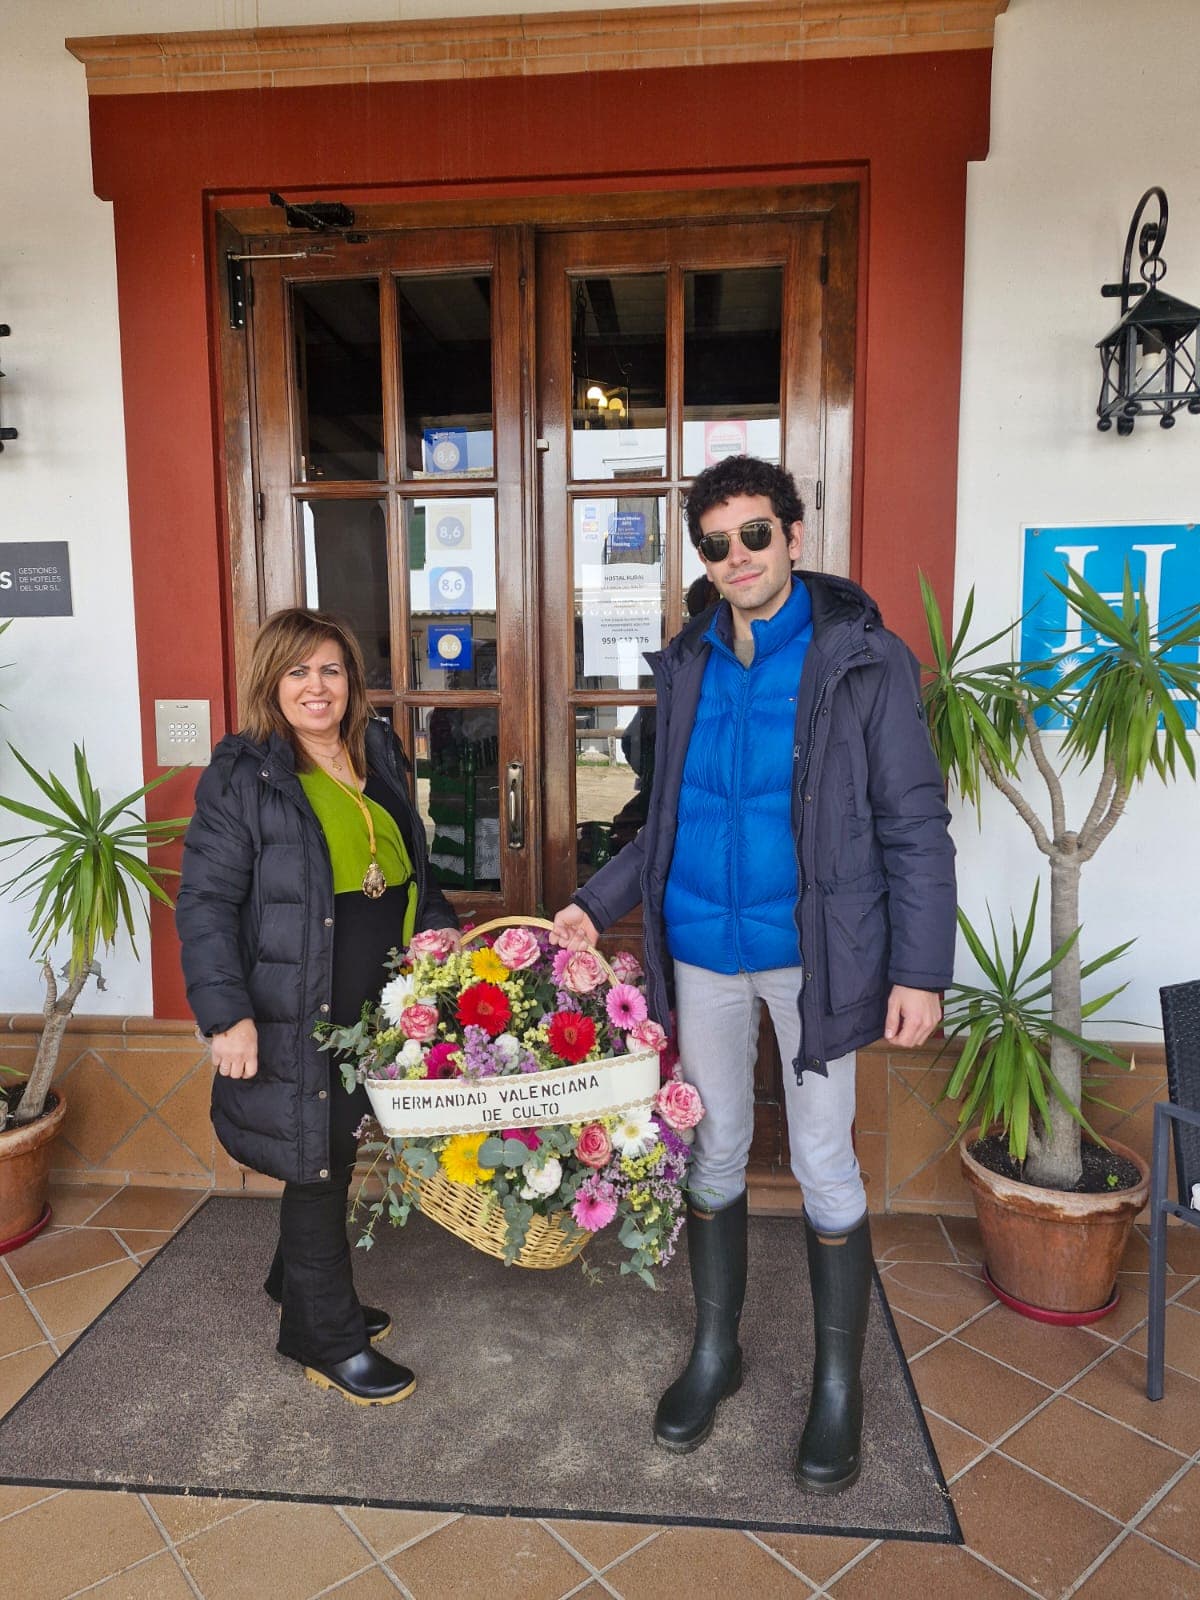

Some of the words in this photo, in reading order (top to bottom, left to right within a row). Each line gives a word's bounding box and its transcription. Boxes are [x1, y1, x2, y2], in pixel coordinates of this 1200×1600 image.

[439, 526, 461, 540] 8,6
[18, 566, 58, 575] GESTIONES
[29, 575, 62, 583] HOTELES
[442, 579, 462, 592] 8,6
[601, 637, 617, 645] 959
[391, 1091, 487, 1110] HERMANDAD
[499, 1075, 600, 1103] VALENCIANA
[482, 1108, 502, 1122] DE
[512, 1102, 560, 1120] CULTO
